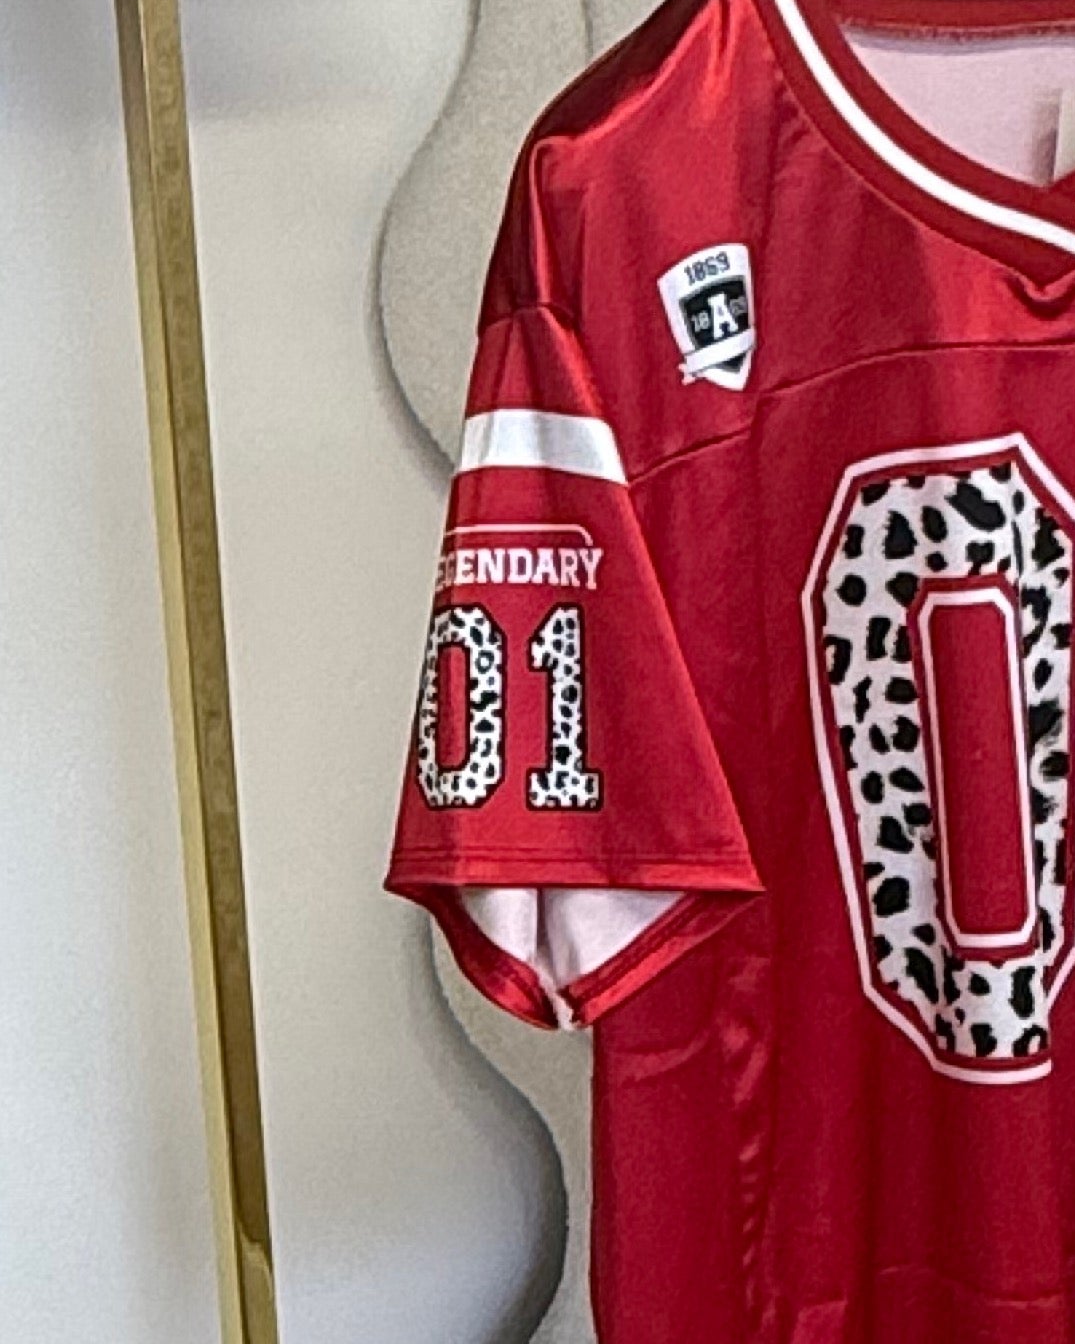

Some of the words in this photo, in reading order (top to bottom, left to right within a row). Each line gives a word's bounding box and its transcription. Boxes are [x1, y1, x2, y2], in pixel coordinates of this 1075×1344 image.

[684, 251, 730, 285] 1869
[707, 292, 738, 340] A
[416, 602, 604, 812] 01
